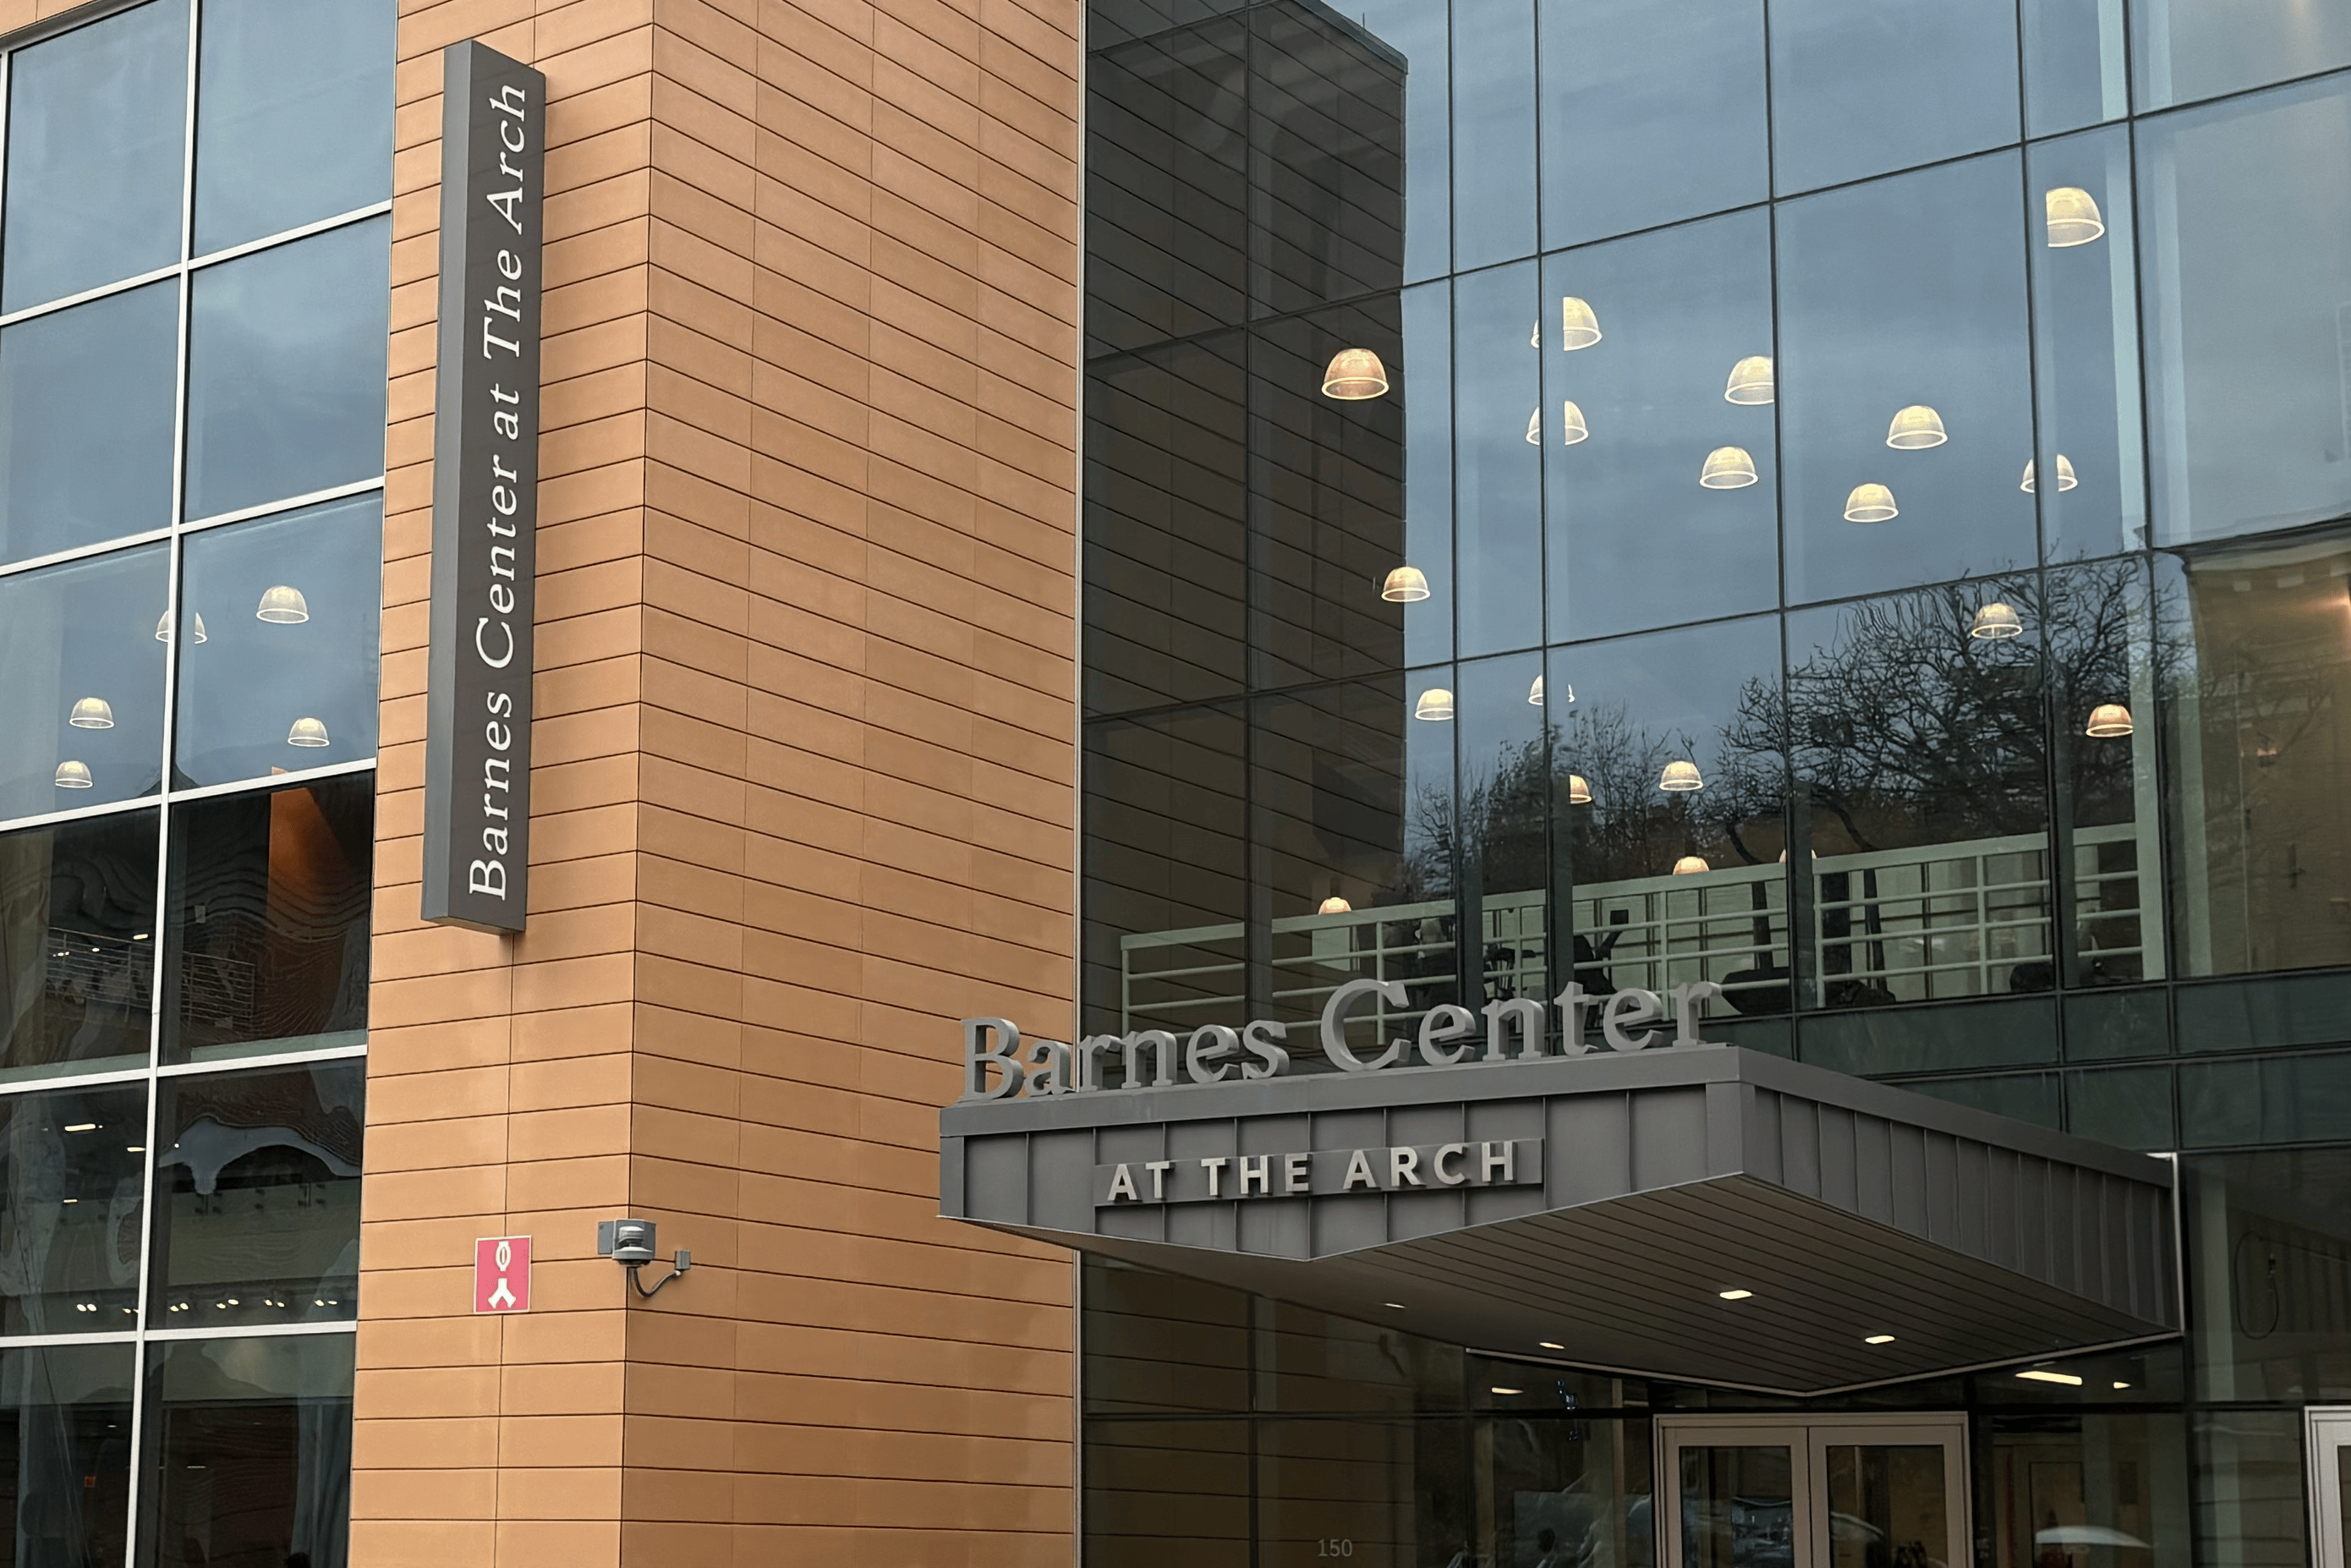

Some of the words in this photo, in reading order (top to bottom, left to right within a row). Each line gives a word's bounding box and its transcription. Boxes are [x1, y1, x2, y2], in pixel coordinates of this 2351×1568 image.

[486, 84, 525, 234] Arch
[483, 249, 522, 359] The
[490, 383, 520, 441] at
[474, 453, 518, 669] Center
[469, 688, 512, 900] Barnes
[960, 1017, 1290, 1102] Barnes
[1319, 978, 1722, 1072] Center
[1106, 1160, 1169, 1202] AT
[1201, 1154, 1310, 1194] THE
[1342, 1140, 1515, 1189] ARCH
[1318, 1538, 1353, 1557] 150
